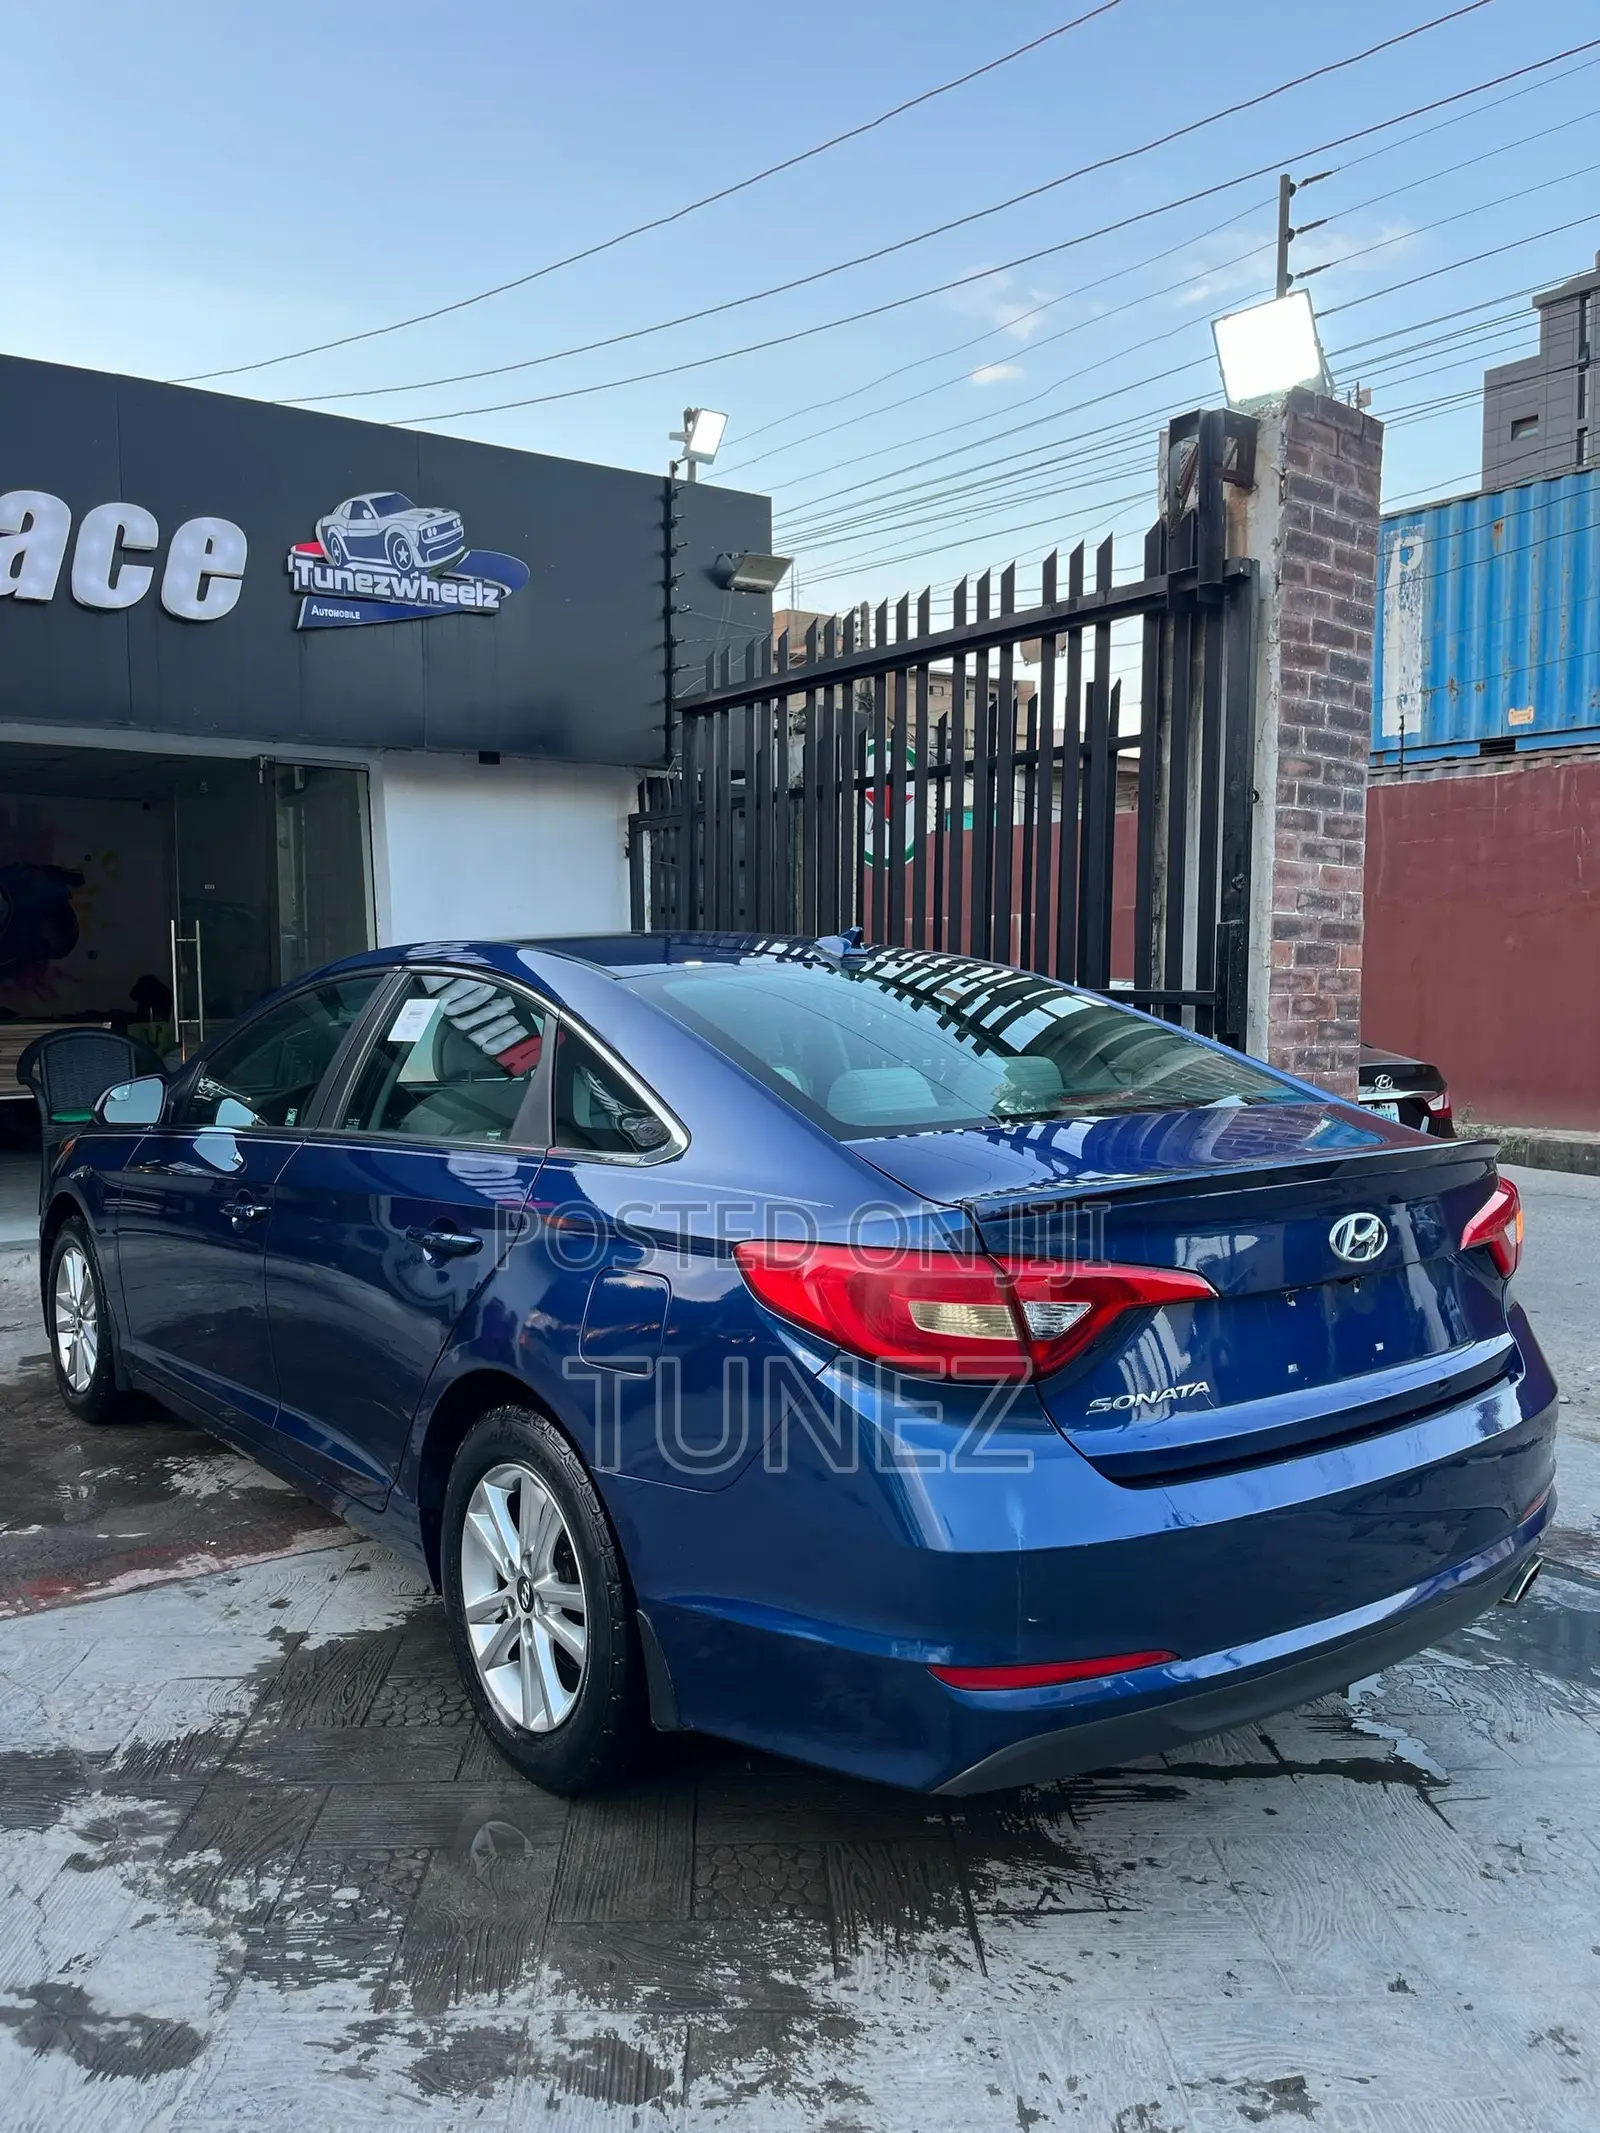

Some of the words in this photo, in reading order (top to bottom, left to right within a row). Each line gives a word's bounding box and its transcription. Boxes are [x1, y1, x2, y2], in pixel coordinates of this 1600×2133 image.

[295, 558, 500, 609] Tunezwheelz
[311, 604, 361, 620] AUTOMOBILE
[1086, 1381, 1211, 1415] SONATA
